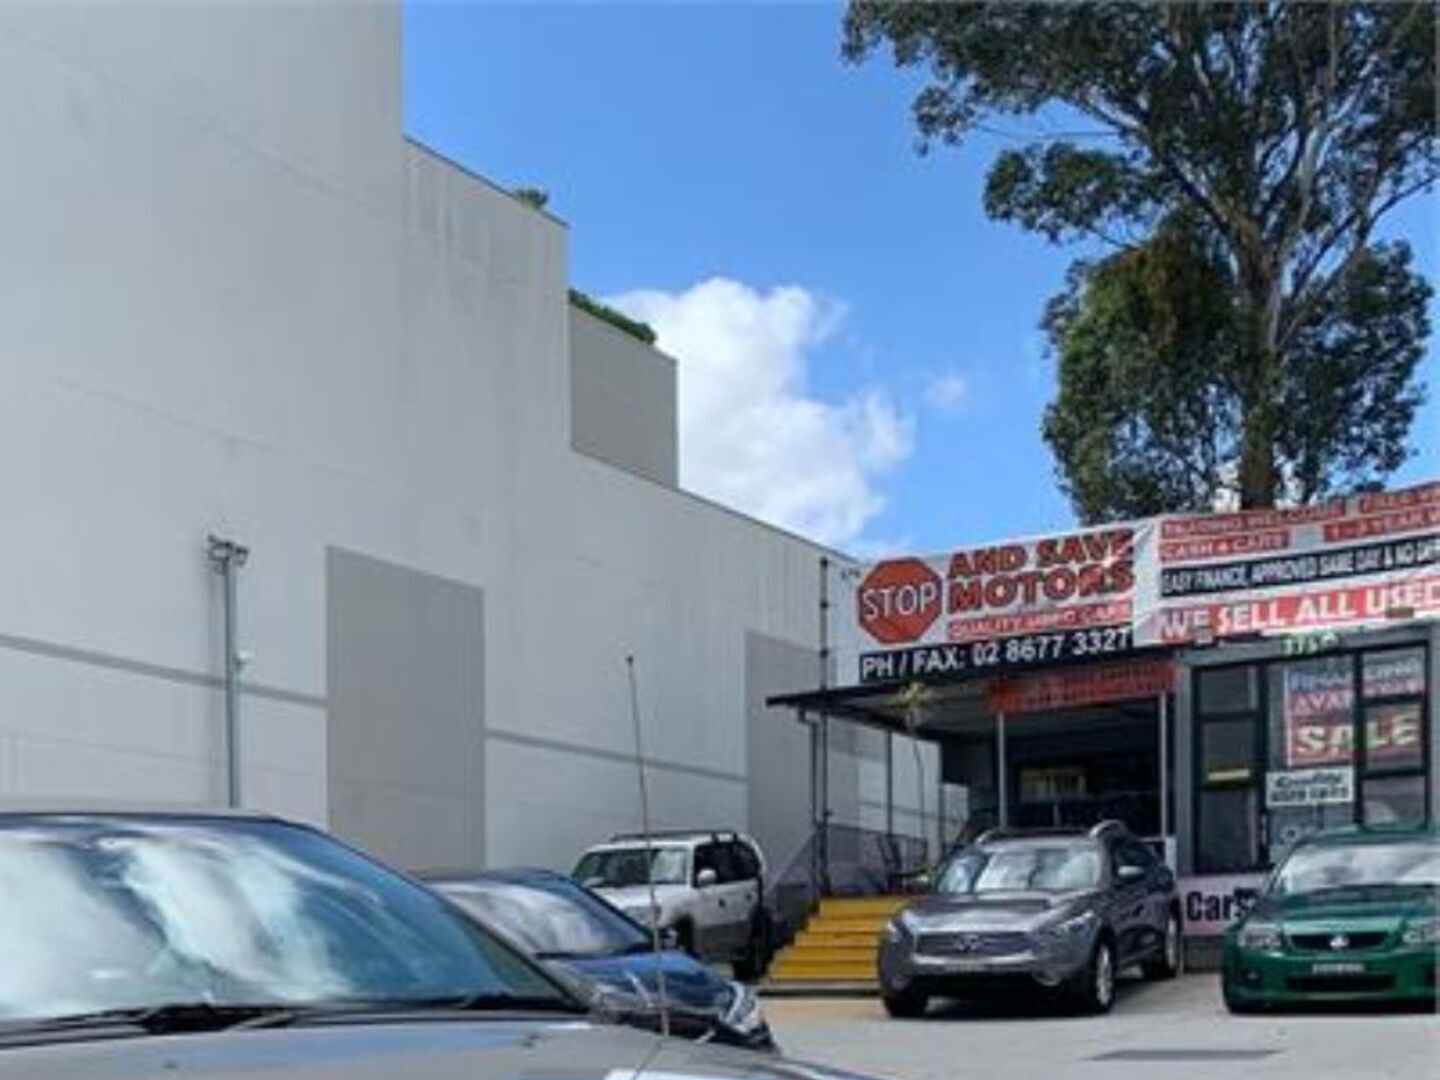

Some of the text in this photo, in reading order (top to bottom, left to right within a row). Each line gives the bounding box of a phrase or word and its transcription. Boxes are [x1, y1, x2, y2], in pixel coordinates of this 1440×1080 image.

[949, 528, 1134, 578] AND SAVE
[862, 581, 937, 621] STOP
[949, 561, 1135, 614] MOTORS
[1161, 605, 1210, 639] WE
[1215, 601, 1287, 635] SELL
[1294, 592, 1358, 626] ALL
[862, 656, 894, 680] PH
[912, 648, 966, 676] FAX:
[972, 641, 1000, 668] 02
[1008, 635, 1065, 664] 8677
[1075, 627, 1128, 657] 3327
[1296, 713, 1419, 757] SALE
